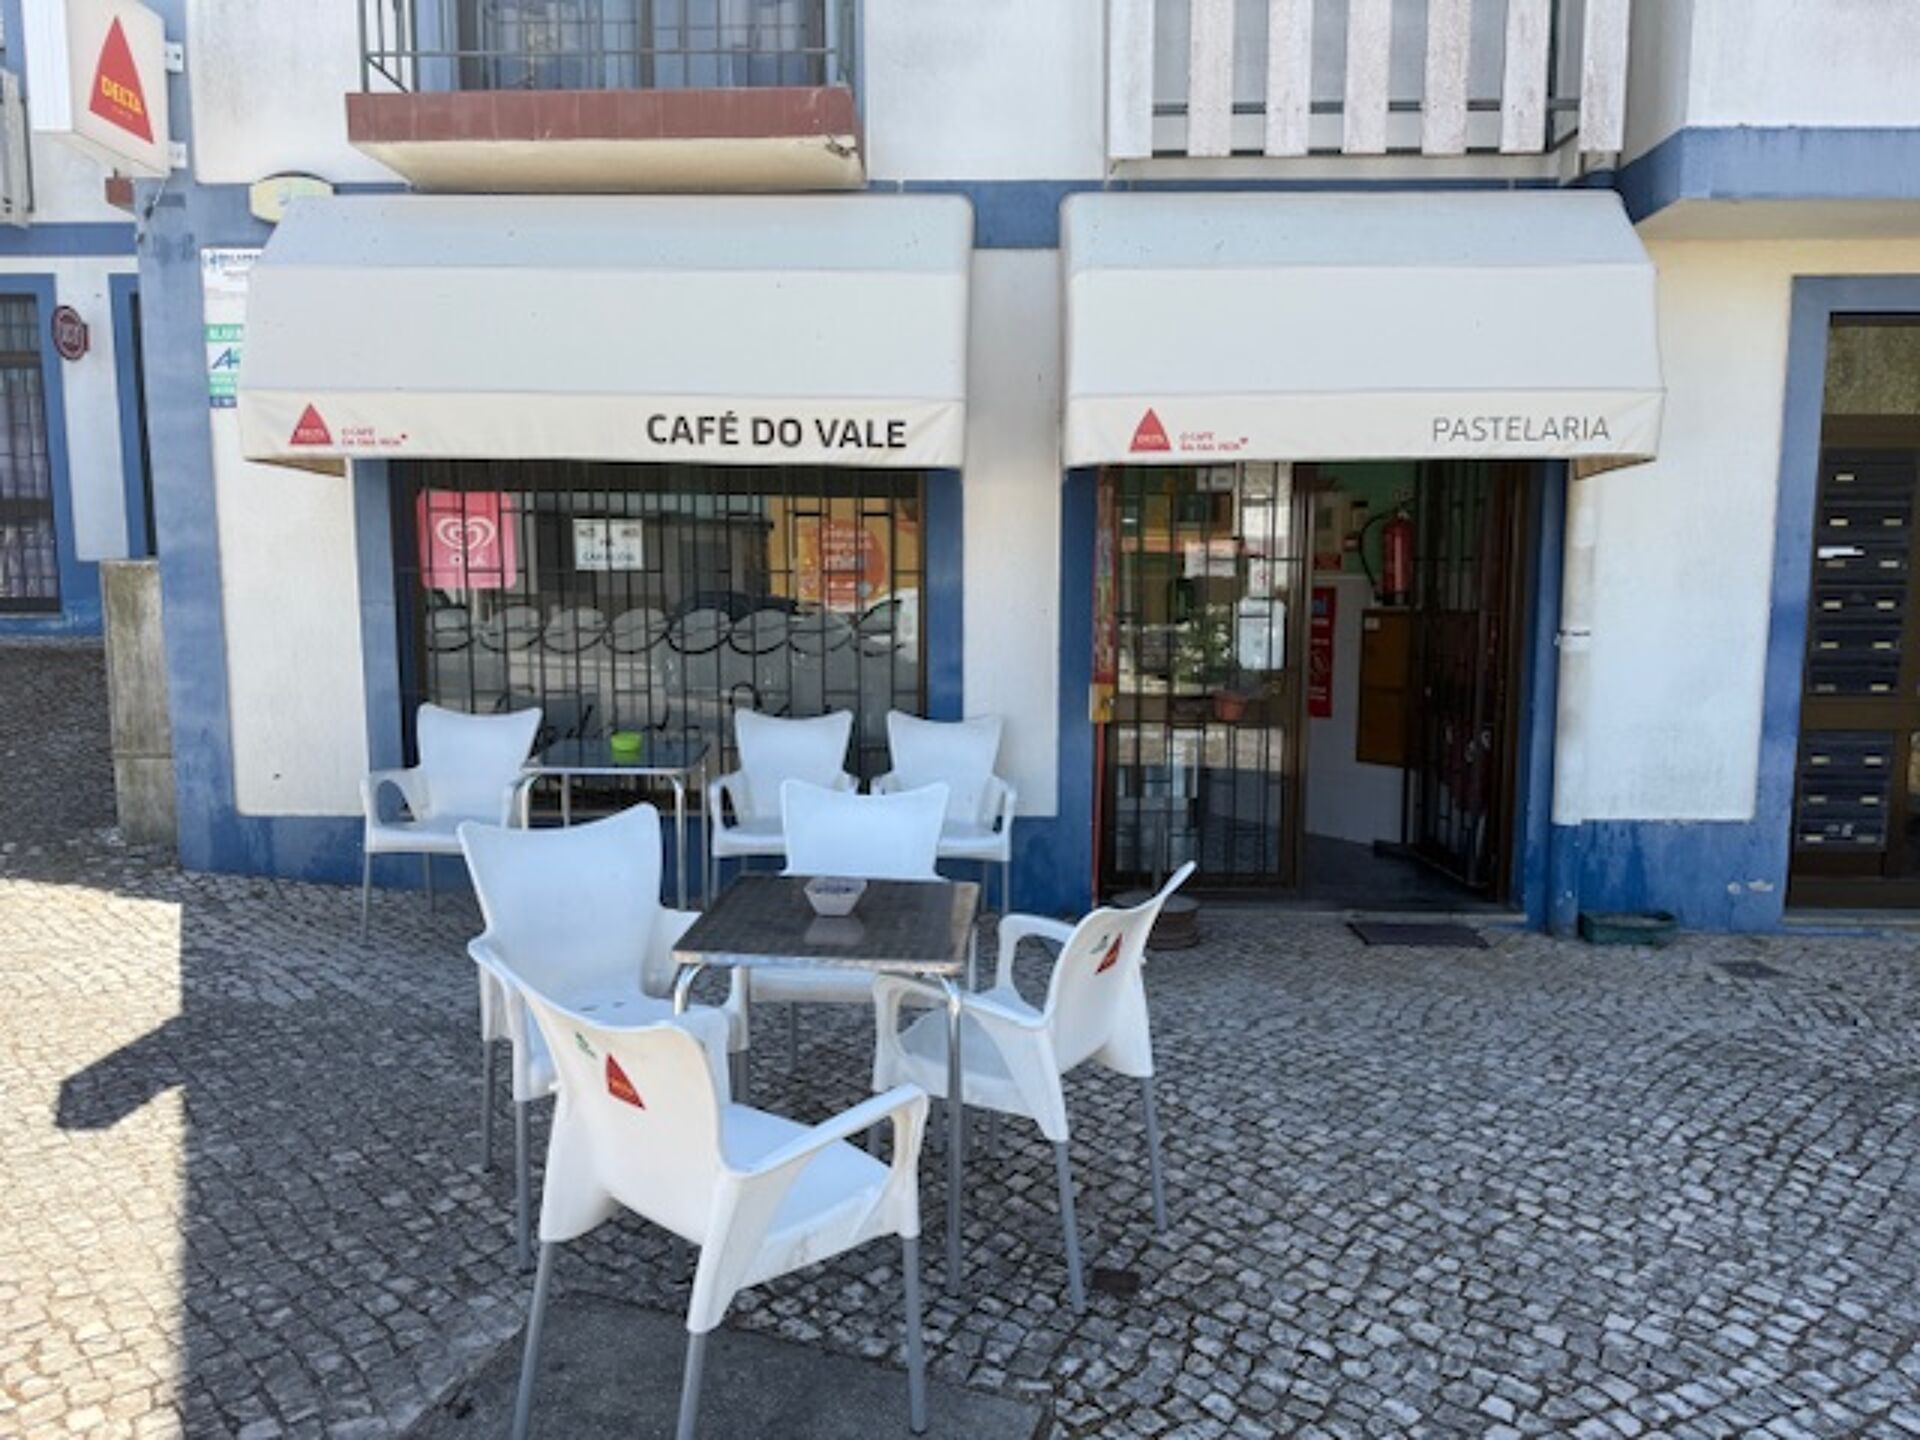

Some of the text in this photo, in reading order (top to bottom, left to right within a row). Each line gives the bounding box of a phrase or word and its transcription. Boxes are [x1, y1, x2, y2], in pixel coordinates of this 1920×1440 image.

[101, 75, 144, 114] DELTA
[646, 410, 908, 449] CAFÉ DO VALE
[1432, 415, 1612, 442] PASTELARIA
